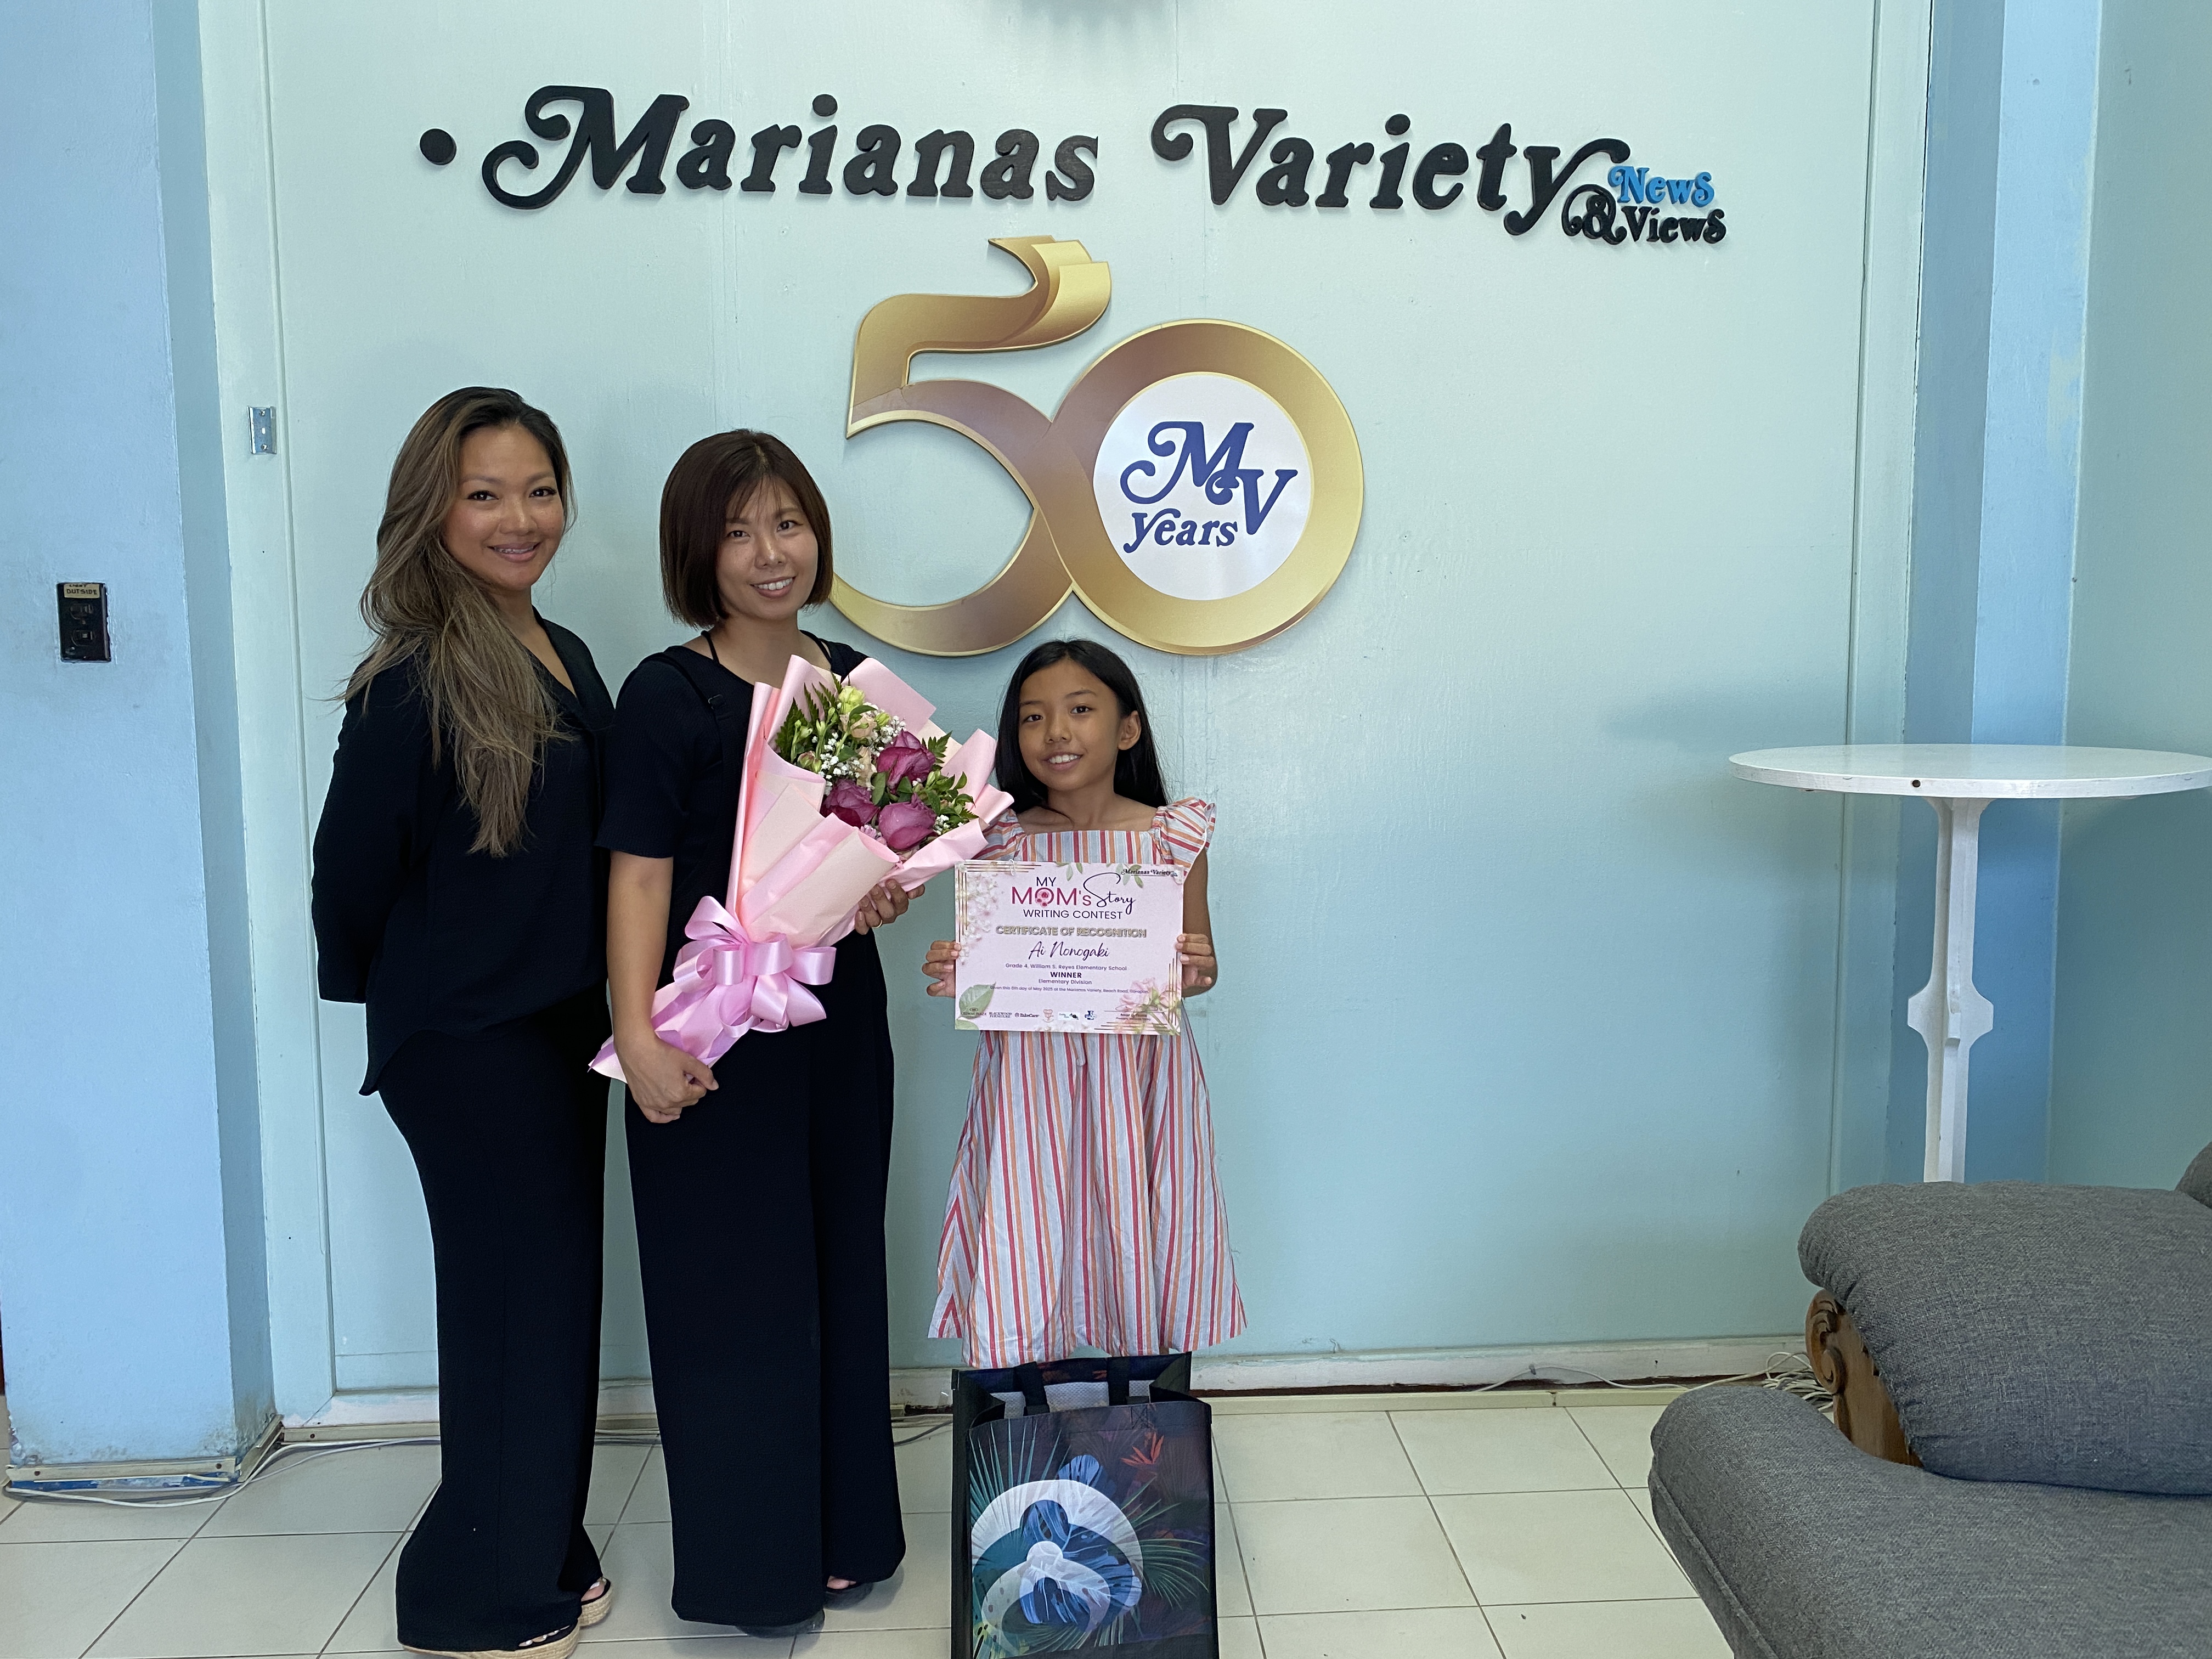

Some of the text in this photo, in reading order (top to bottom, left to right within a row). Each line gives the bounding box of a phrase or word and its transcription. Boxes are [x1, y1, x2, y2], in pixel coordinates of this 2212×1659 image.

[481, 85, 1631, 236] Marianas Variety
[1608, 165, 1714, 208] News
[1619, 208, 1726, 244] Views
[830, 235, 1364, 656] 50
[1012, 872, 1135, 915] MOM's Story
[1036, 877, 1056, 886] MY
[996, 926, 1147, 938] CERTIFICATE OF RECOGNITION
[1023, 910, 1122, 919] WRITING CONTEST
[1029, 941, 1110, 961] Ai Nonogaki
